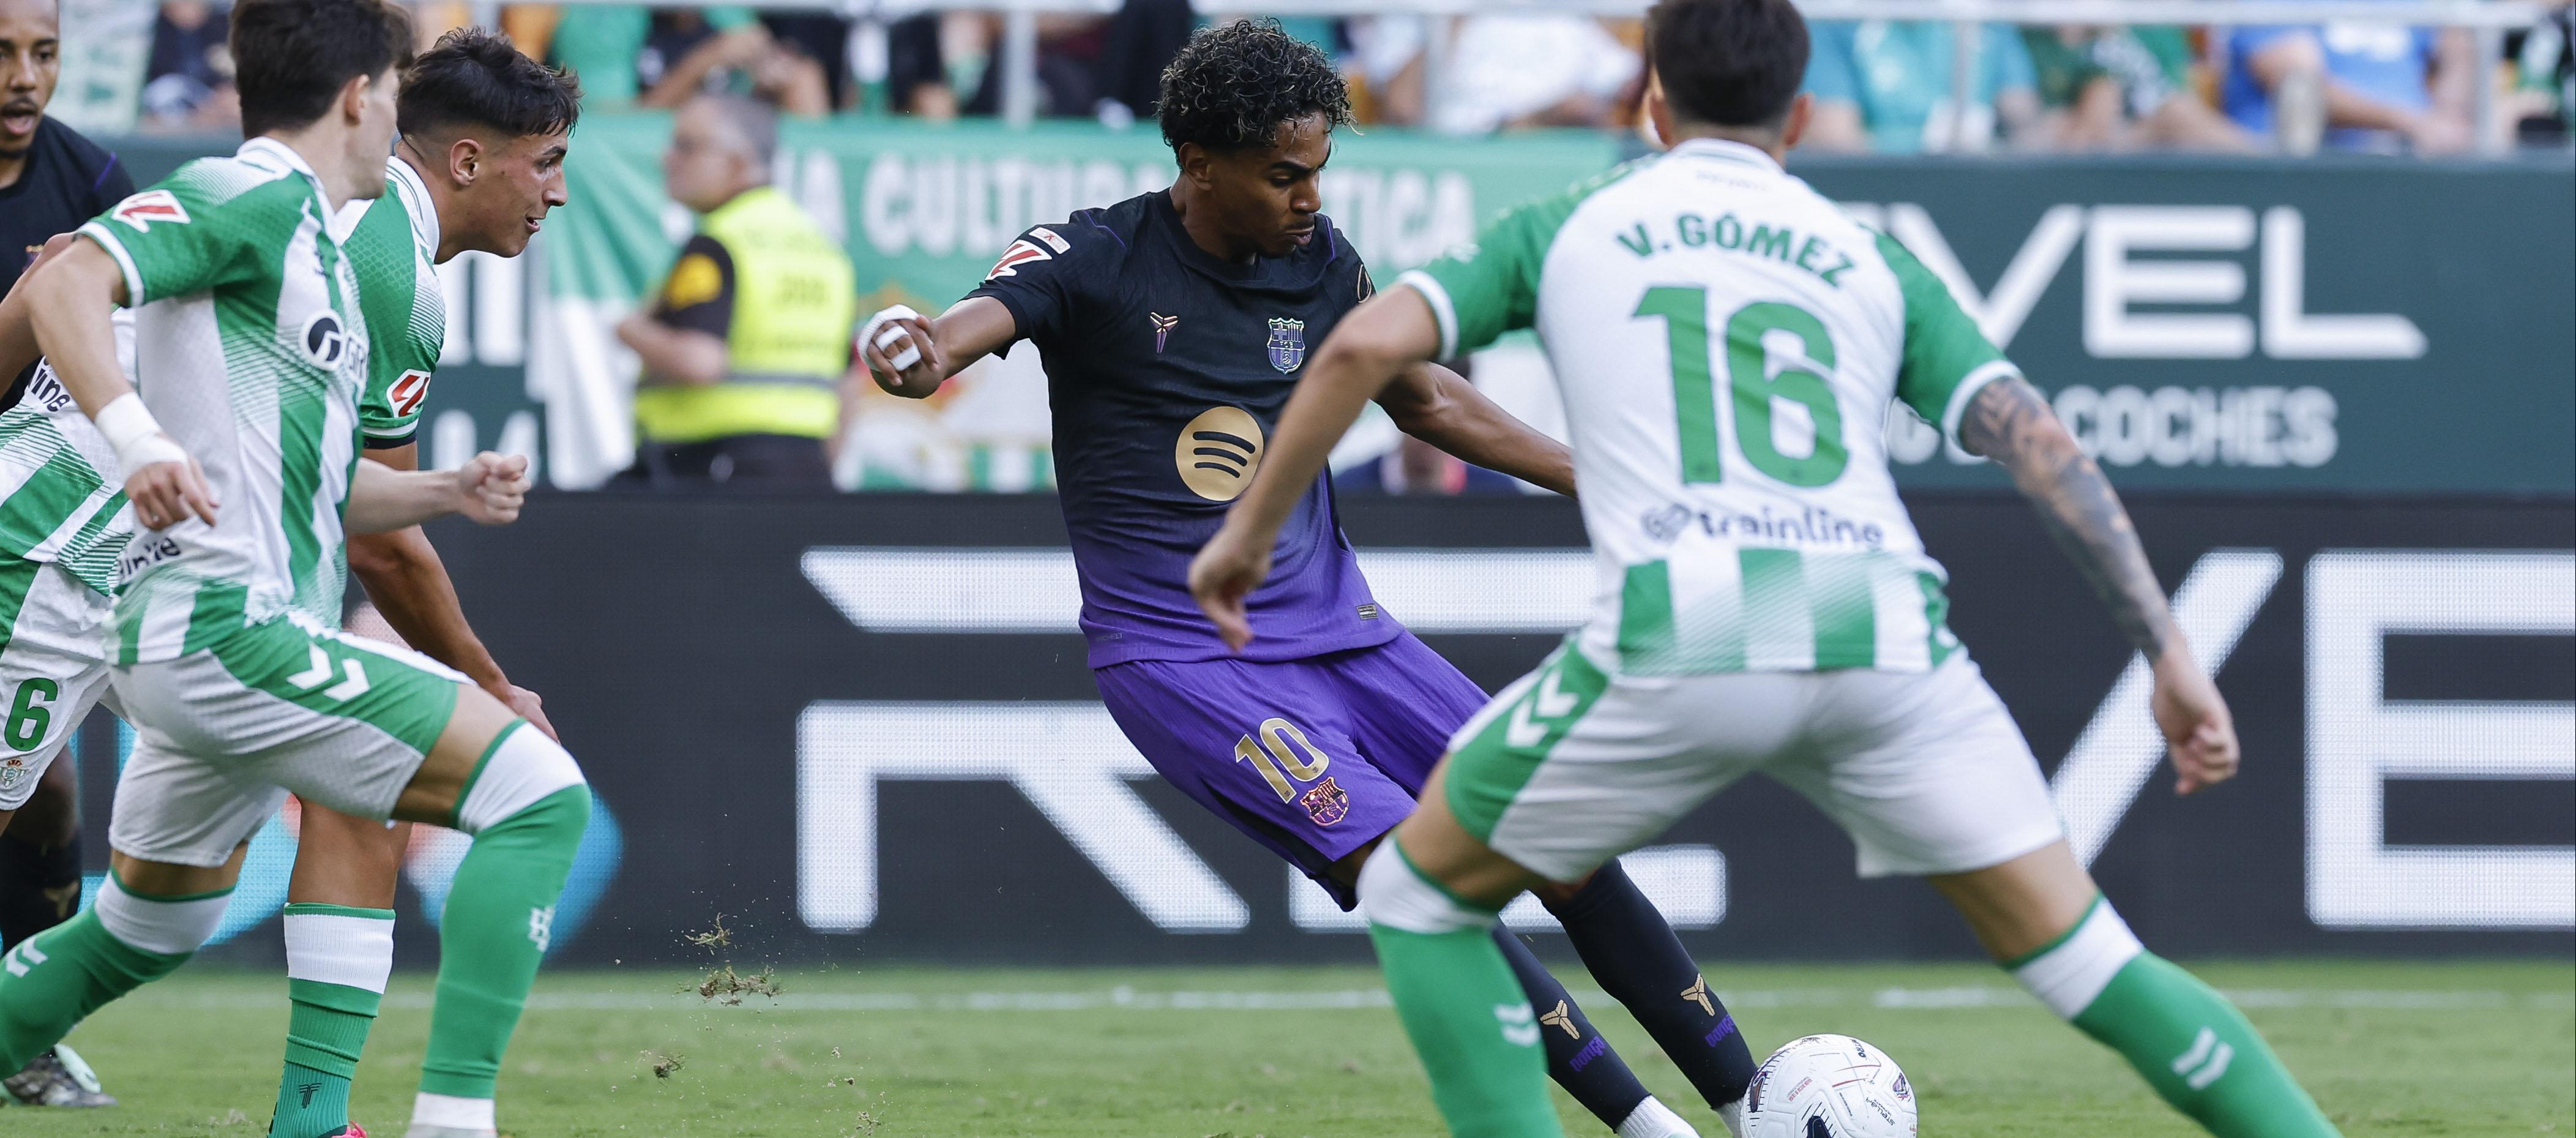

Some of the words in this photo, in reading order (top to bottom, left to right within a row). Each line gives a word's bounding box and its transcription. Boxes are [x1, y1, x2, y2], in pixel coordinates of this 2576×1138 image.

[1838, 201, 2428, 360] VEL
[1631, 285, 1849, 488] 16
[2051, 385, 2339, 467] COCHES
[1700, 505, 1884, 545] trainline
[4, 677, 58, 752] 6
[1234, 717, 1329, 804] 10
